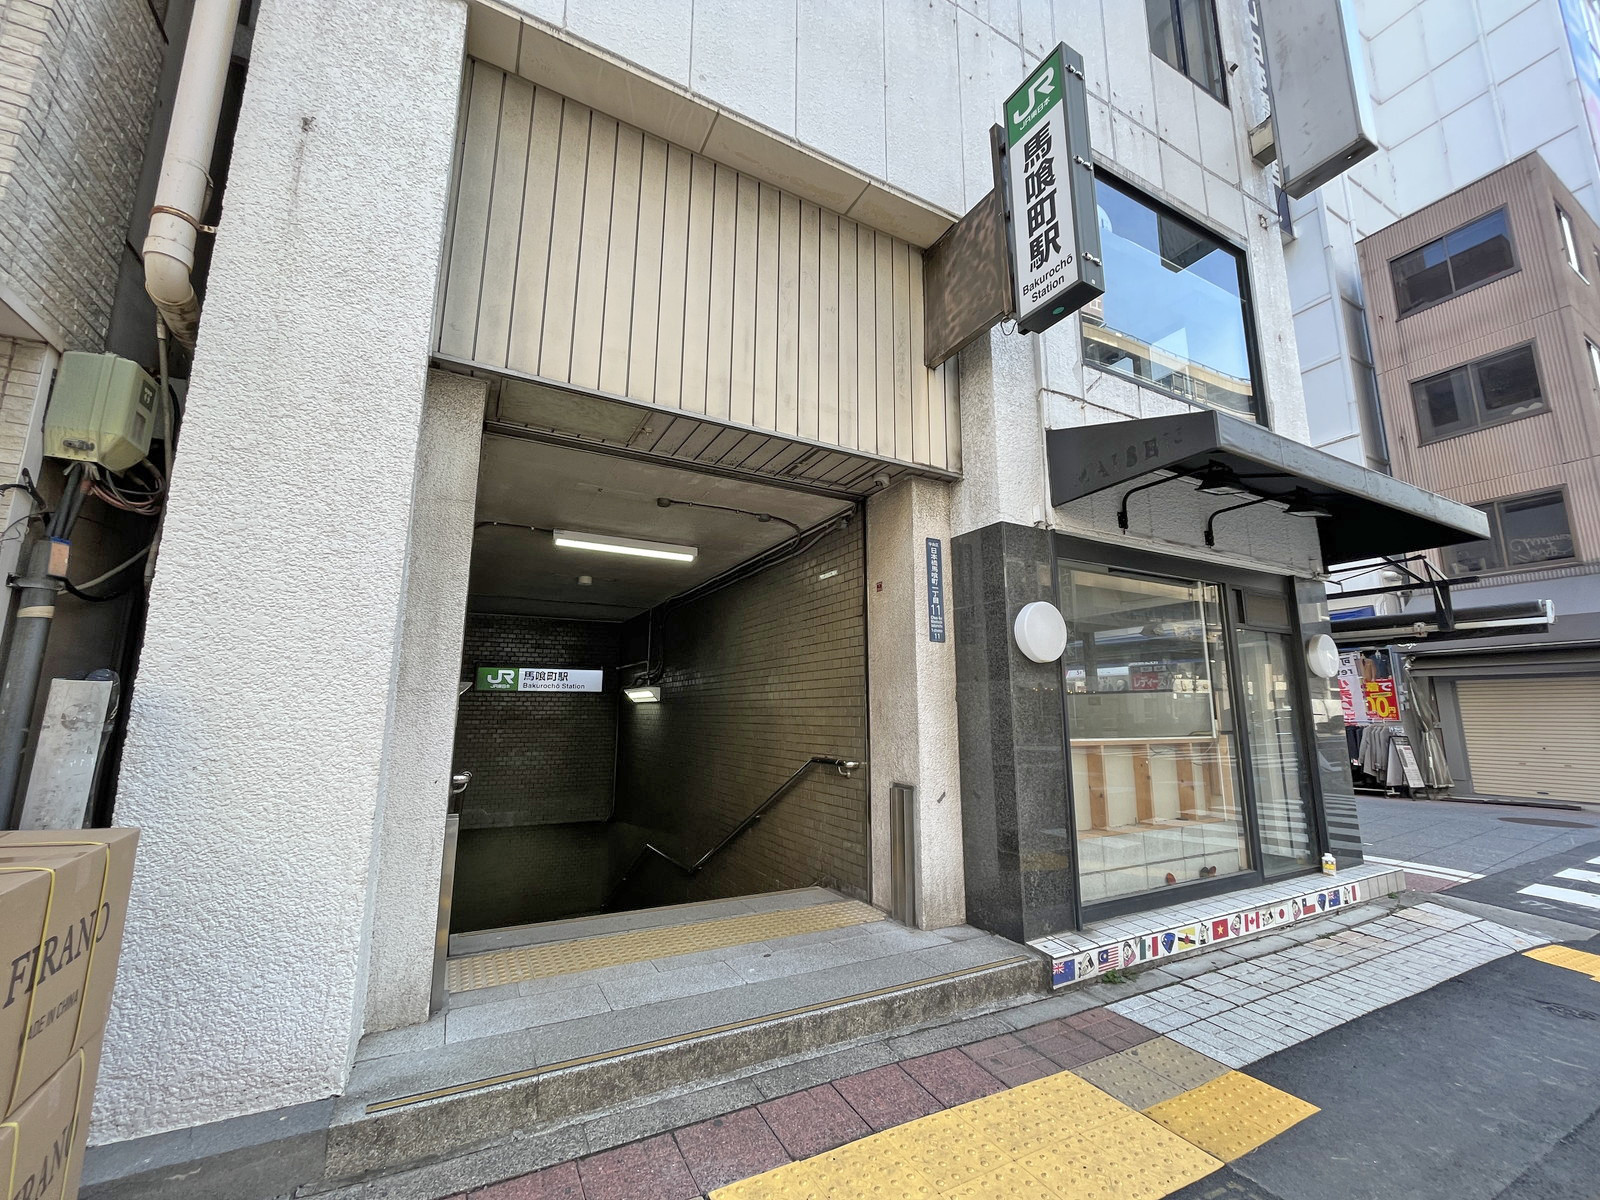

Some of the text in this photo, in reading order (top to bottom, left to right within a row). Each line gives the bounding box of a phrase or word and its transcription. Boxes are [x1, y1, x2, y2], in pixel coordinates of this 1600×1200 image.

[1013, 66, 1055, 125] JR
[1019, 96, 1051, 131] JR東日本
[1023, 121, 1062, 273] 馬喰町駅
[1031, 274, 1065, 303] Station
[930, 604, 941, 616] 11
[487, 669, 515, 684] JR
[523, 670, 569, 682] 馬喰町駅
